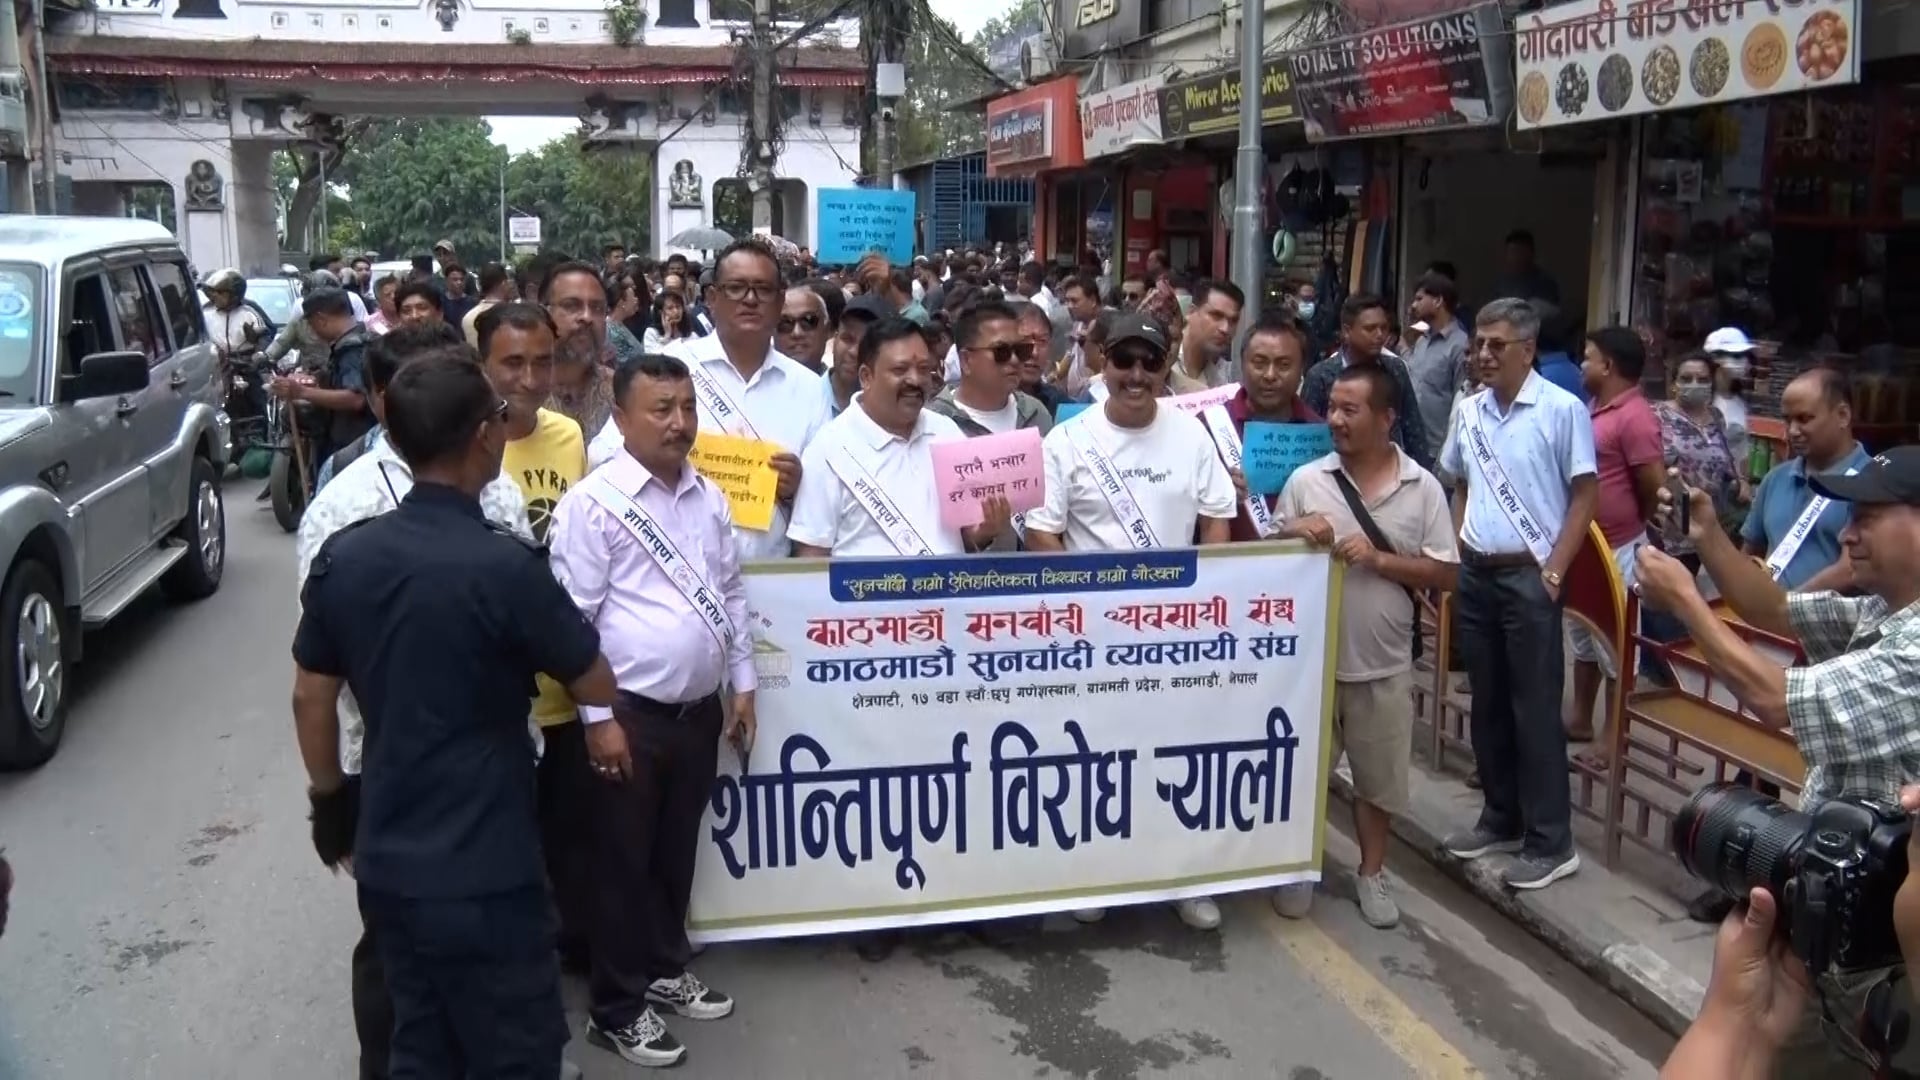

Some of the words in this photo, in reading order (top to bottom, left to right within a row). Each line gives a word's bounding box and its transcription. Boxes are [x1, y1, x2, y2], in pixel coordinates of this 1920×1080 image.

[1290, 47, 1338, 77] TOTAL
[1340, 42, 1356, 68] IT
[1361, 13, 1479, 65] SOLUTIONS
[1184, 85, 1218, 110] Mirror
[954, 456, 984, 481] पुरानै
[990, 453, 1027, 470] भन्सार
[949, 488, 965, 503] दर
[693, 586, 725, 628] विरोध
[967, 639, 1096, 682] सुनचाँदी
[1105, 631, 1240, 667] व्यवसायी
[1249, 631, 1300, 661] संघ
[911, 692, 929, 706] १७
[936, 690, 959, 704] वडा
[711, 731, 973, 890] शान्तिपूर्ण
[991, 719, 1139, 851] विरोध
